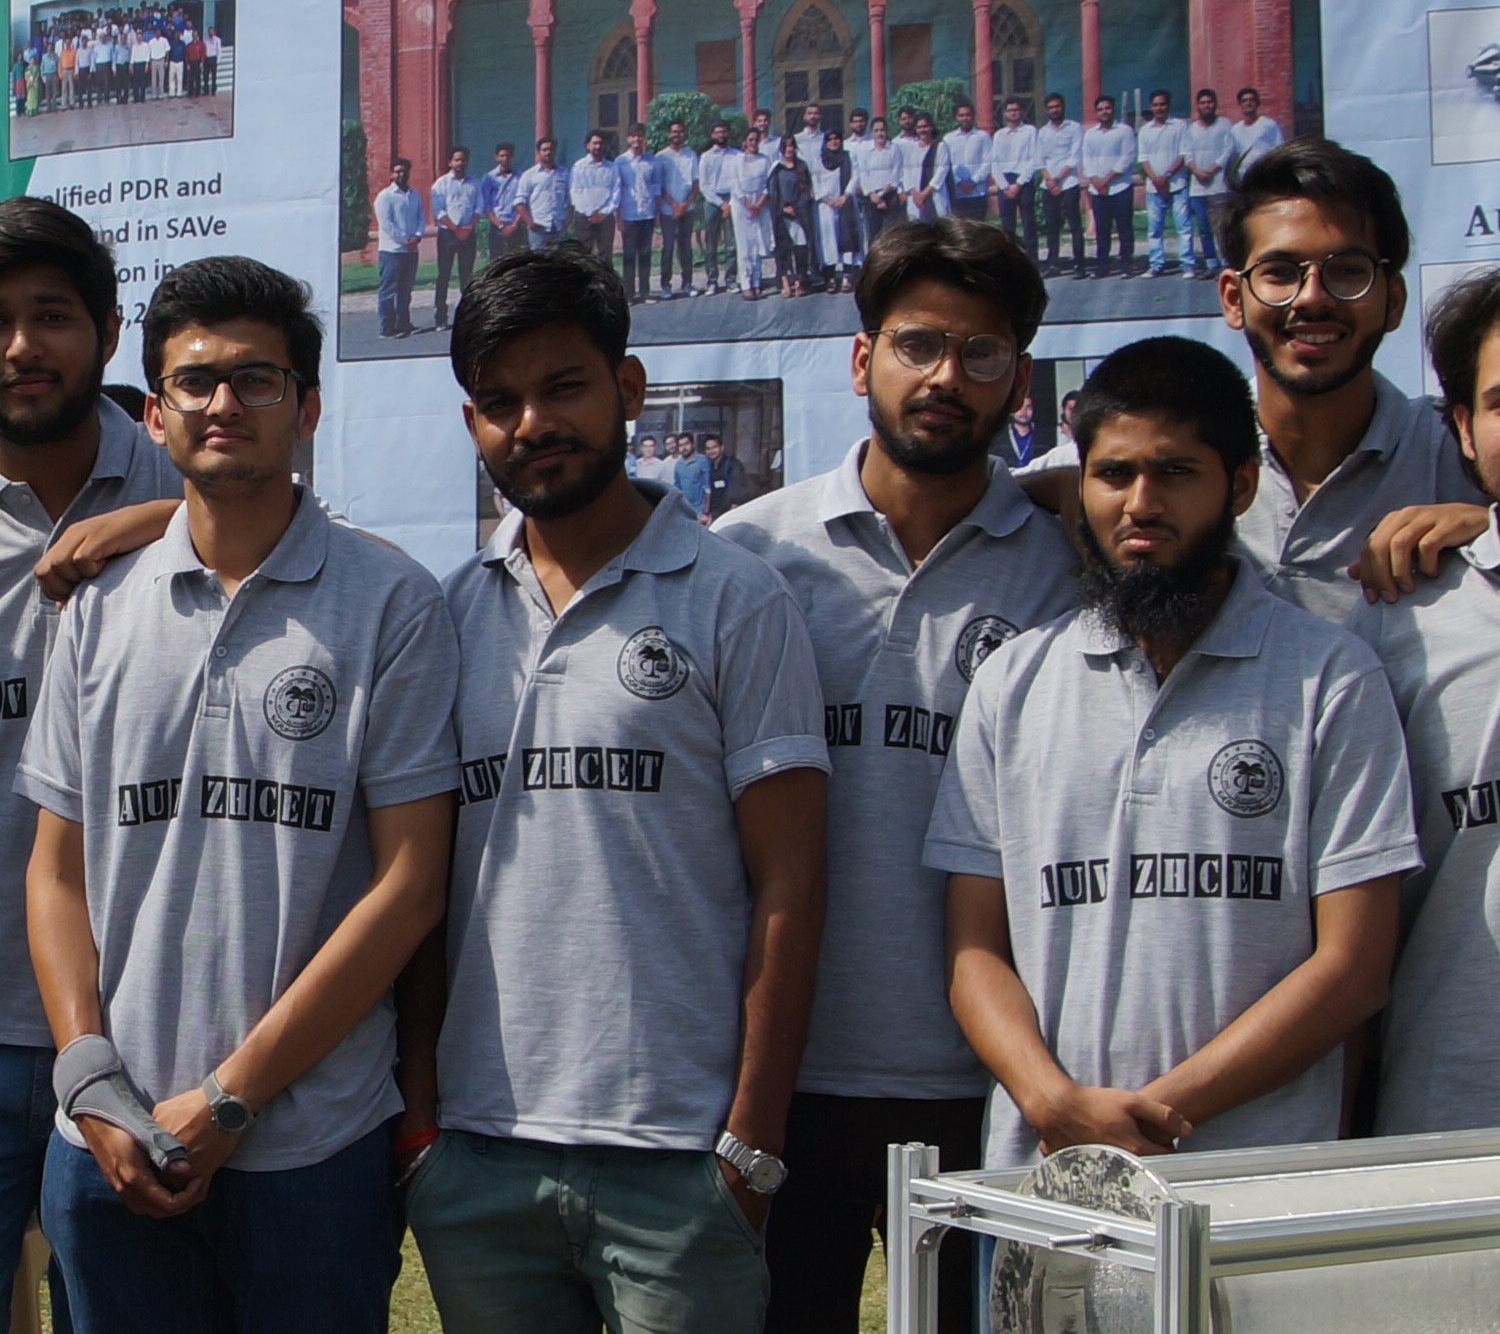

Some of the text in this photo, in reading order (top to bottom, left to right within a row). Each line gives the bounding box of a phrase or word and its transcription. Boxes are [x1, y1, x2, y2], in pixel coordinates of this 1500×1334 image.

[119, 172, 223, 202] PDR and
[136, 221, 159, 243] in
[165, 215, 228, 240] SAVe
[521, 746, 666, 793] ZHCET
[200, 774, 336, 832] ZHCET
[1128, 852, 1283, 902] ZHCET
